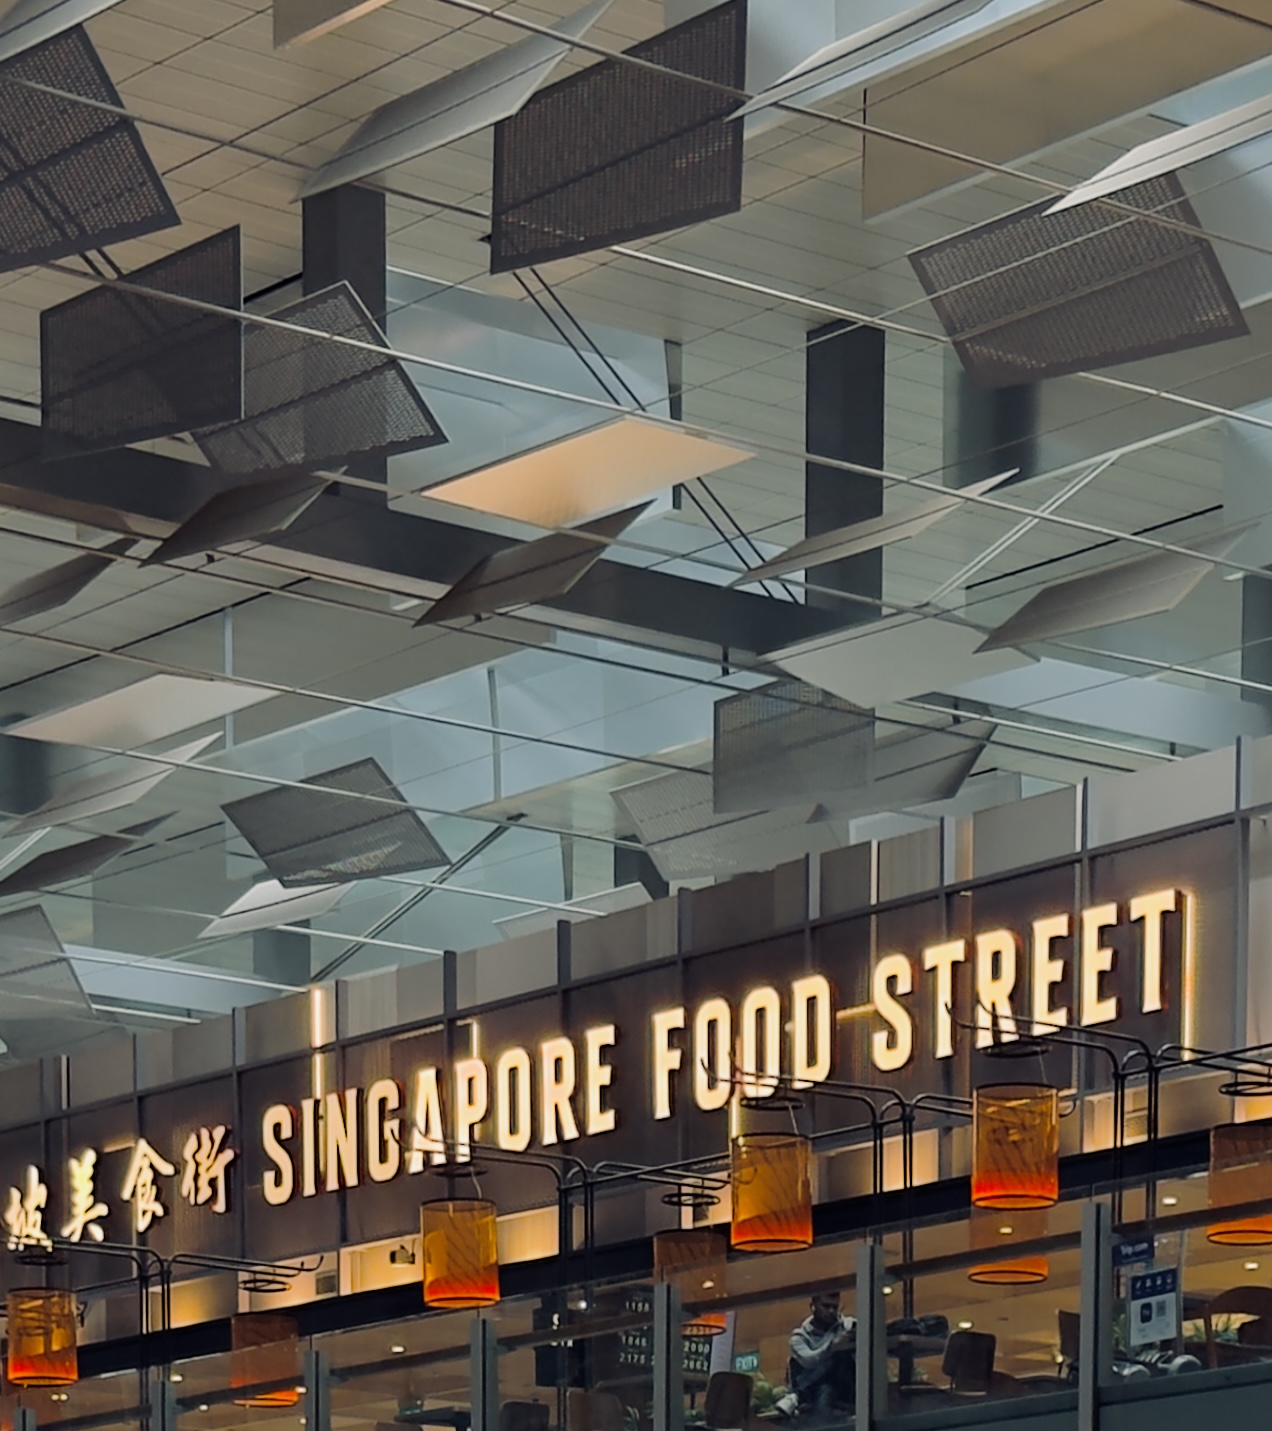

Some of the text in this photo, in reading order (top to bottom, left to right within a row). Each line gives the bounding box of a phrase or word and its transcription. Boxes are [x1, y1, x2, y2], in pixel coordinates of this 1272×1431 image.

[261, 888, 1177, 1206] SINGAPORE FOOD STREET
